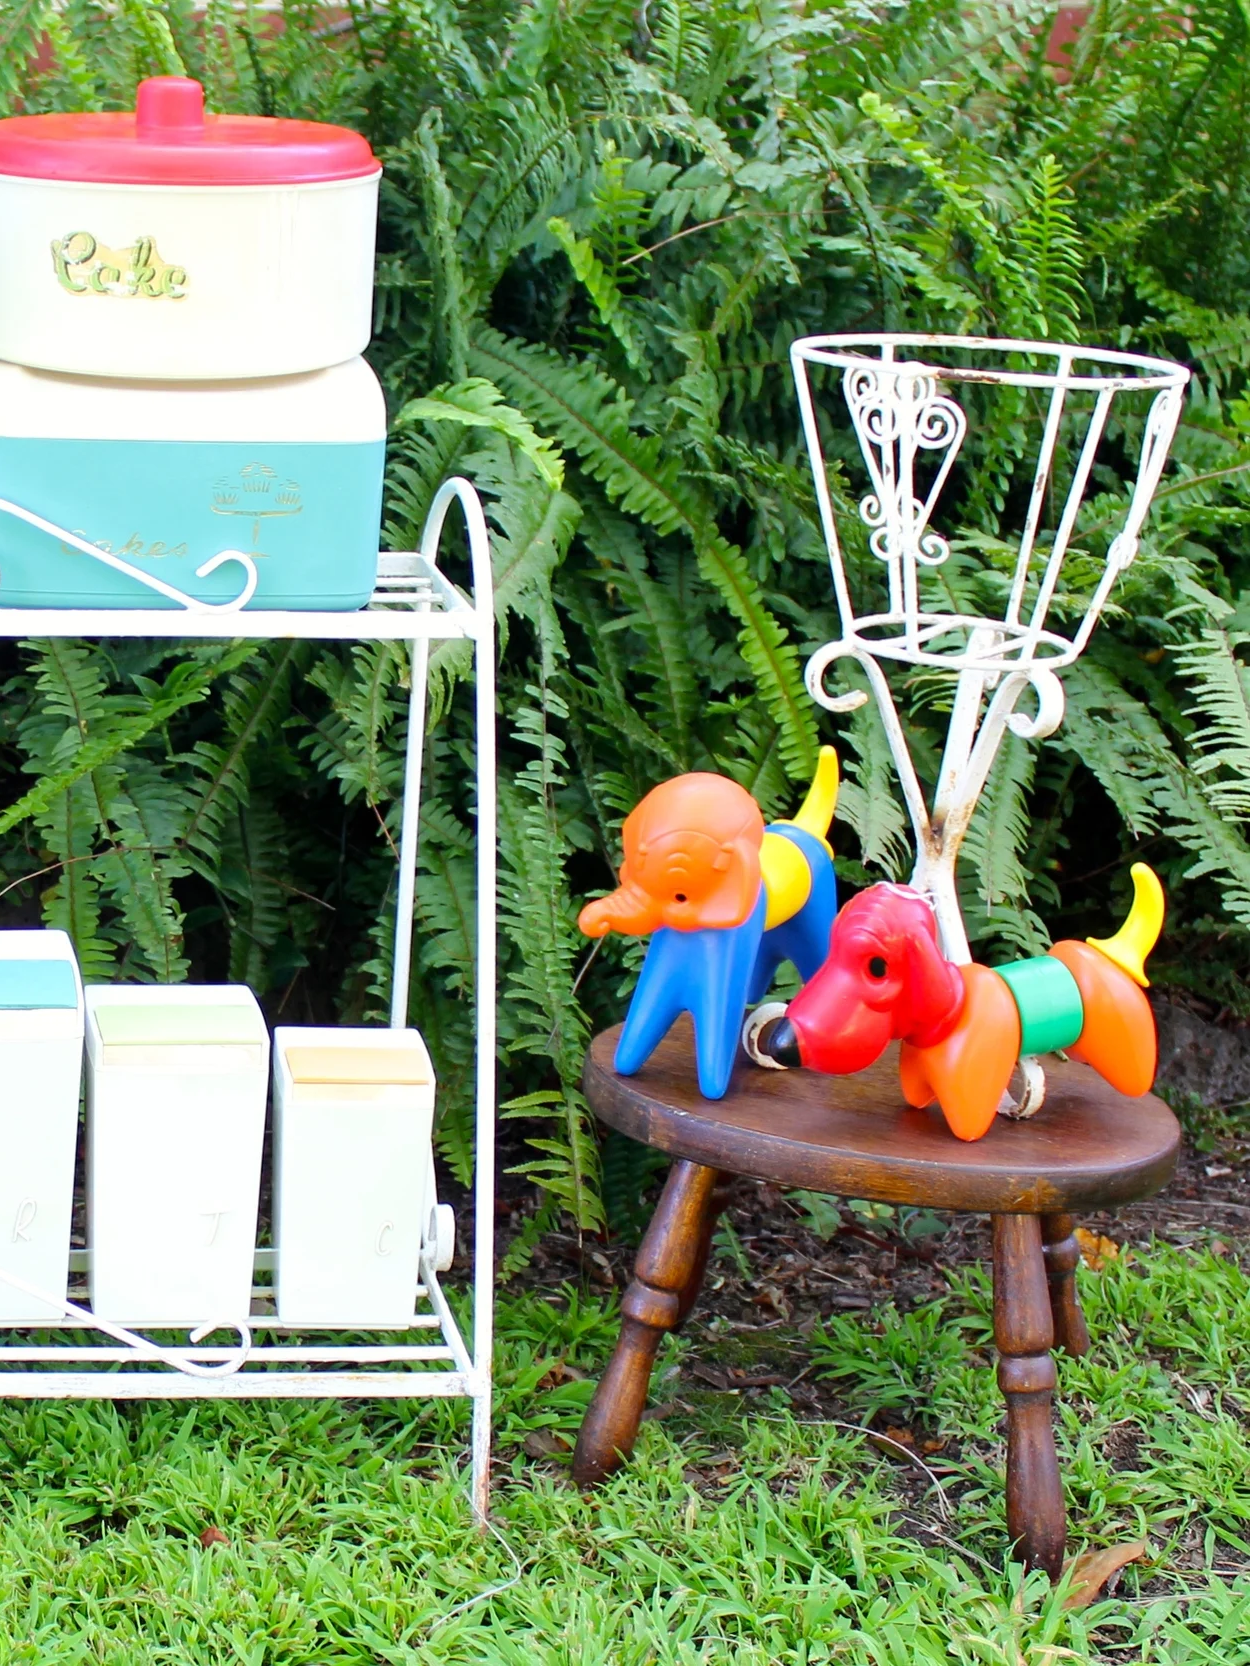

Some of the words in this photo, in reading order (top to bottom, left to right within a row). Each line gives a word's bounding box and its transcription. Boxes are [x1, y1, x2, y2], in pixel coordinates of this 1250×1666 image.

[50, 231, 187, 300] Cake
[11, 1197, 37, 1243] R
[199, 1209, 231, 1247] T
[374, 1219, 394, 1257] C
